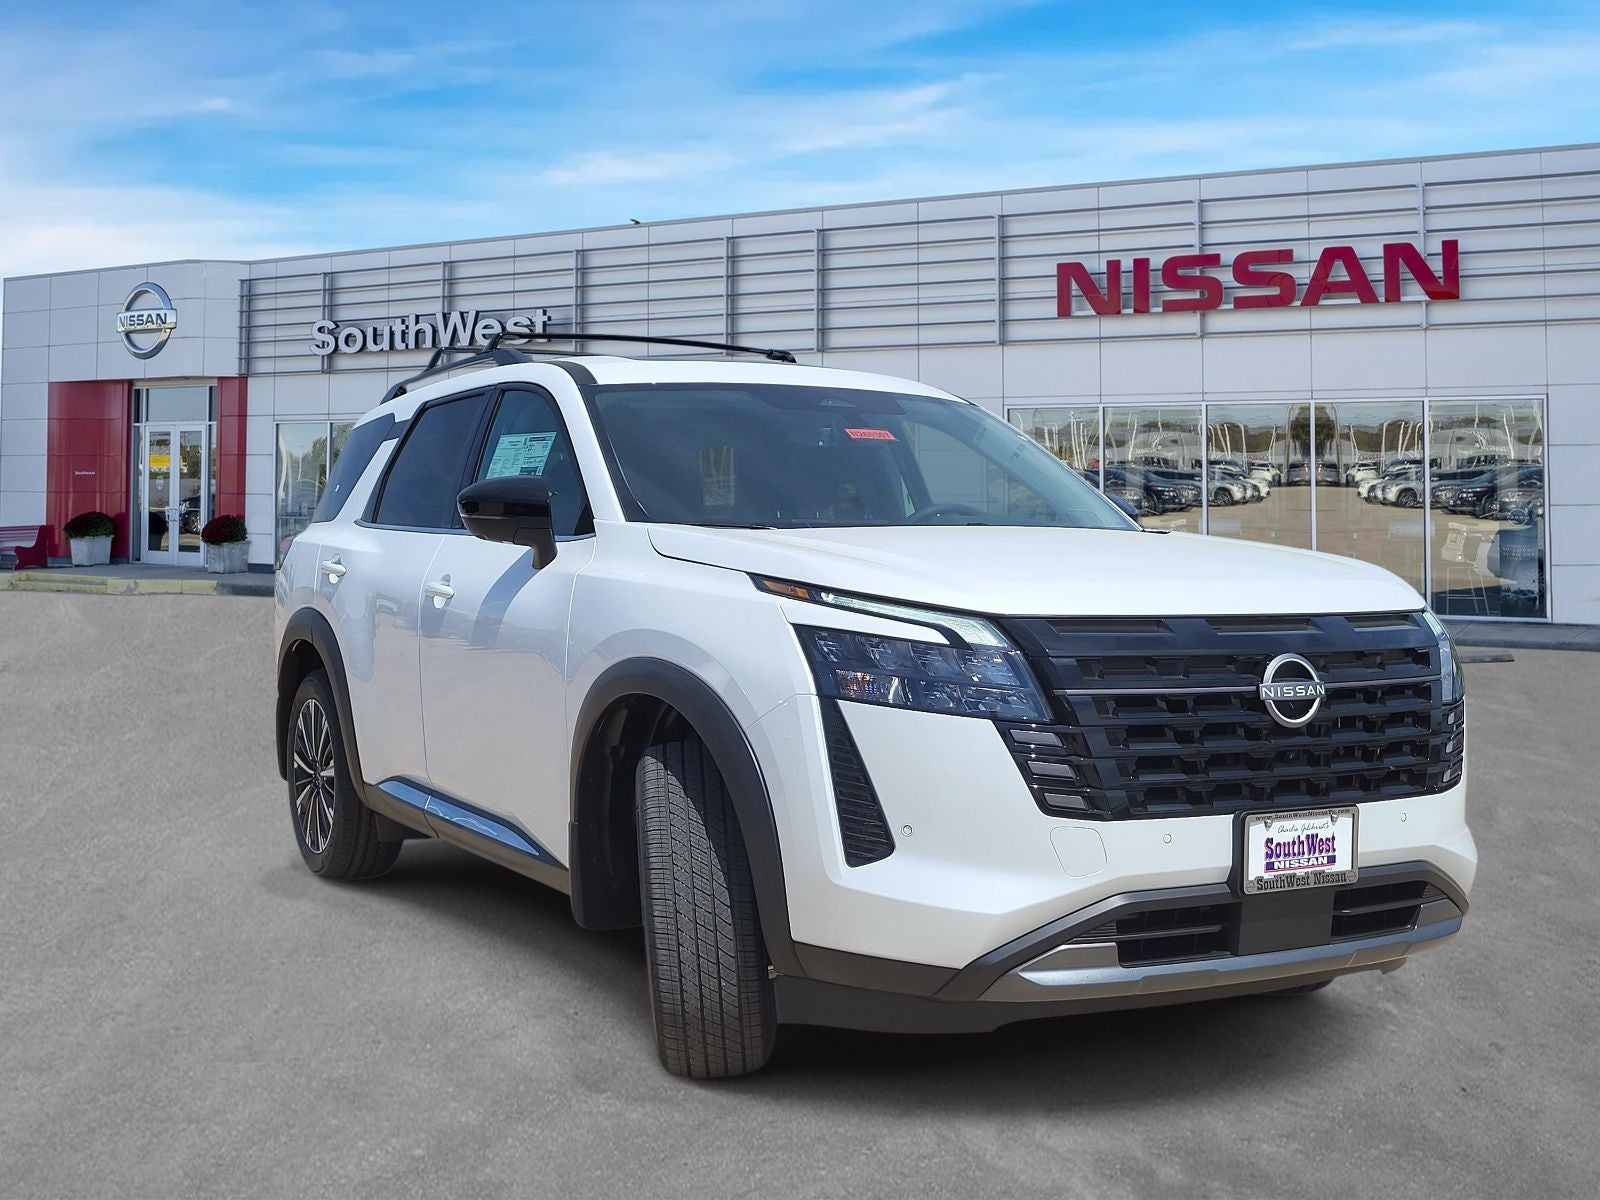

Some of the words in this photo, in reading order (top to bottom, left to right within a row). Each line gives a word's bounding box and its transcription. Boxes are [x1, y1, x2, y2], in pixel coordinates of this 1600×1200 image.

[1057, 239, 1460, 318] NISSAN
[118, 312, 167, 328] NISSAN
[309, 308, 551, 356] SouthWest
[1262, 684, 1325, 698] NISSAN
[1264, 831, 1336, 860] SouthWest
[1273, 856, 1328, 870] NISSAN
[1256, 871, 1310, 891] SouthWest
[1313, 871, 1347, 885] Nissan
